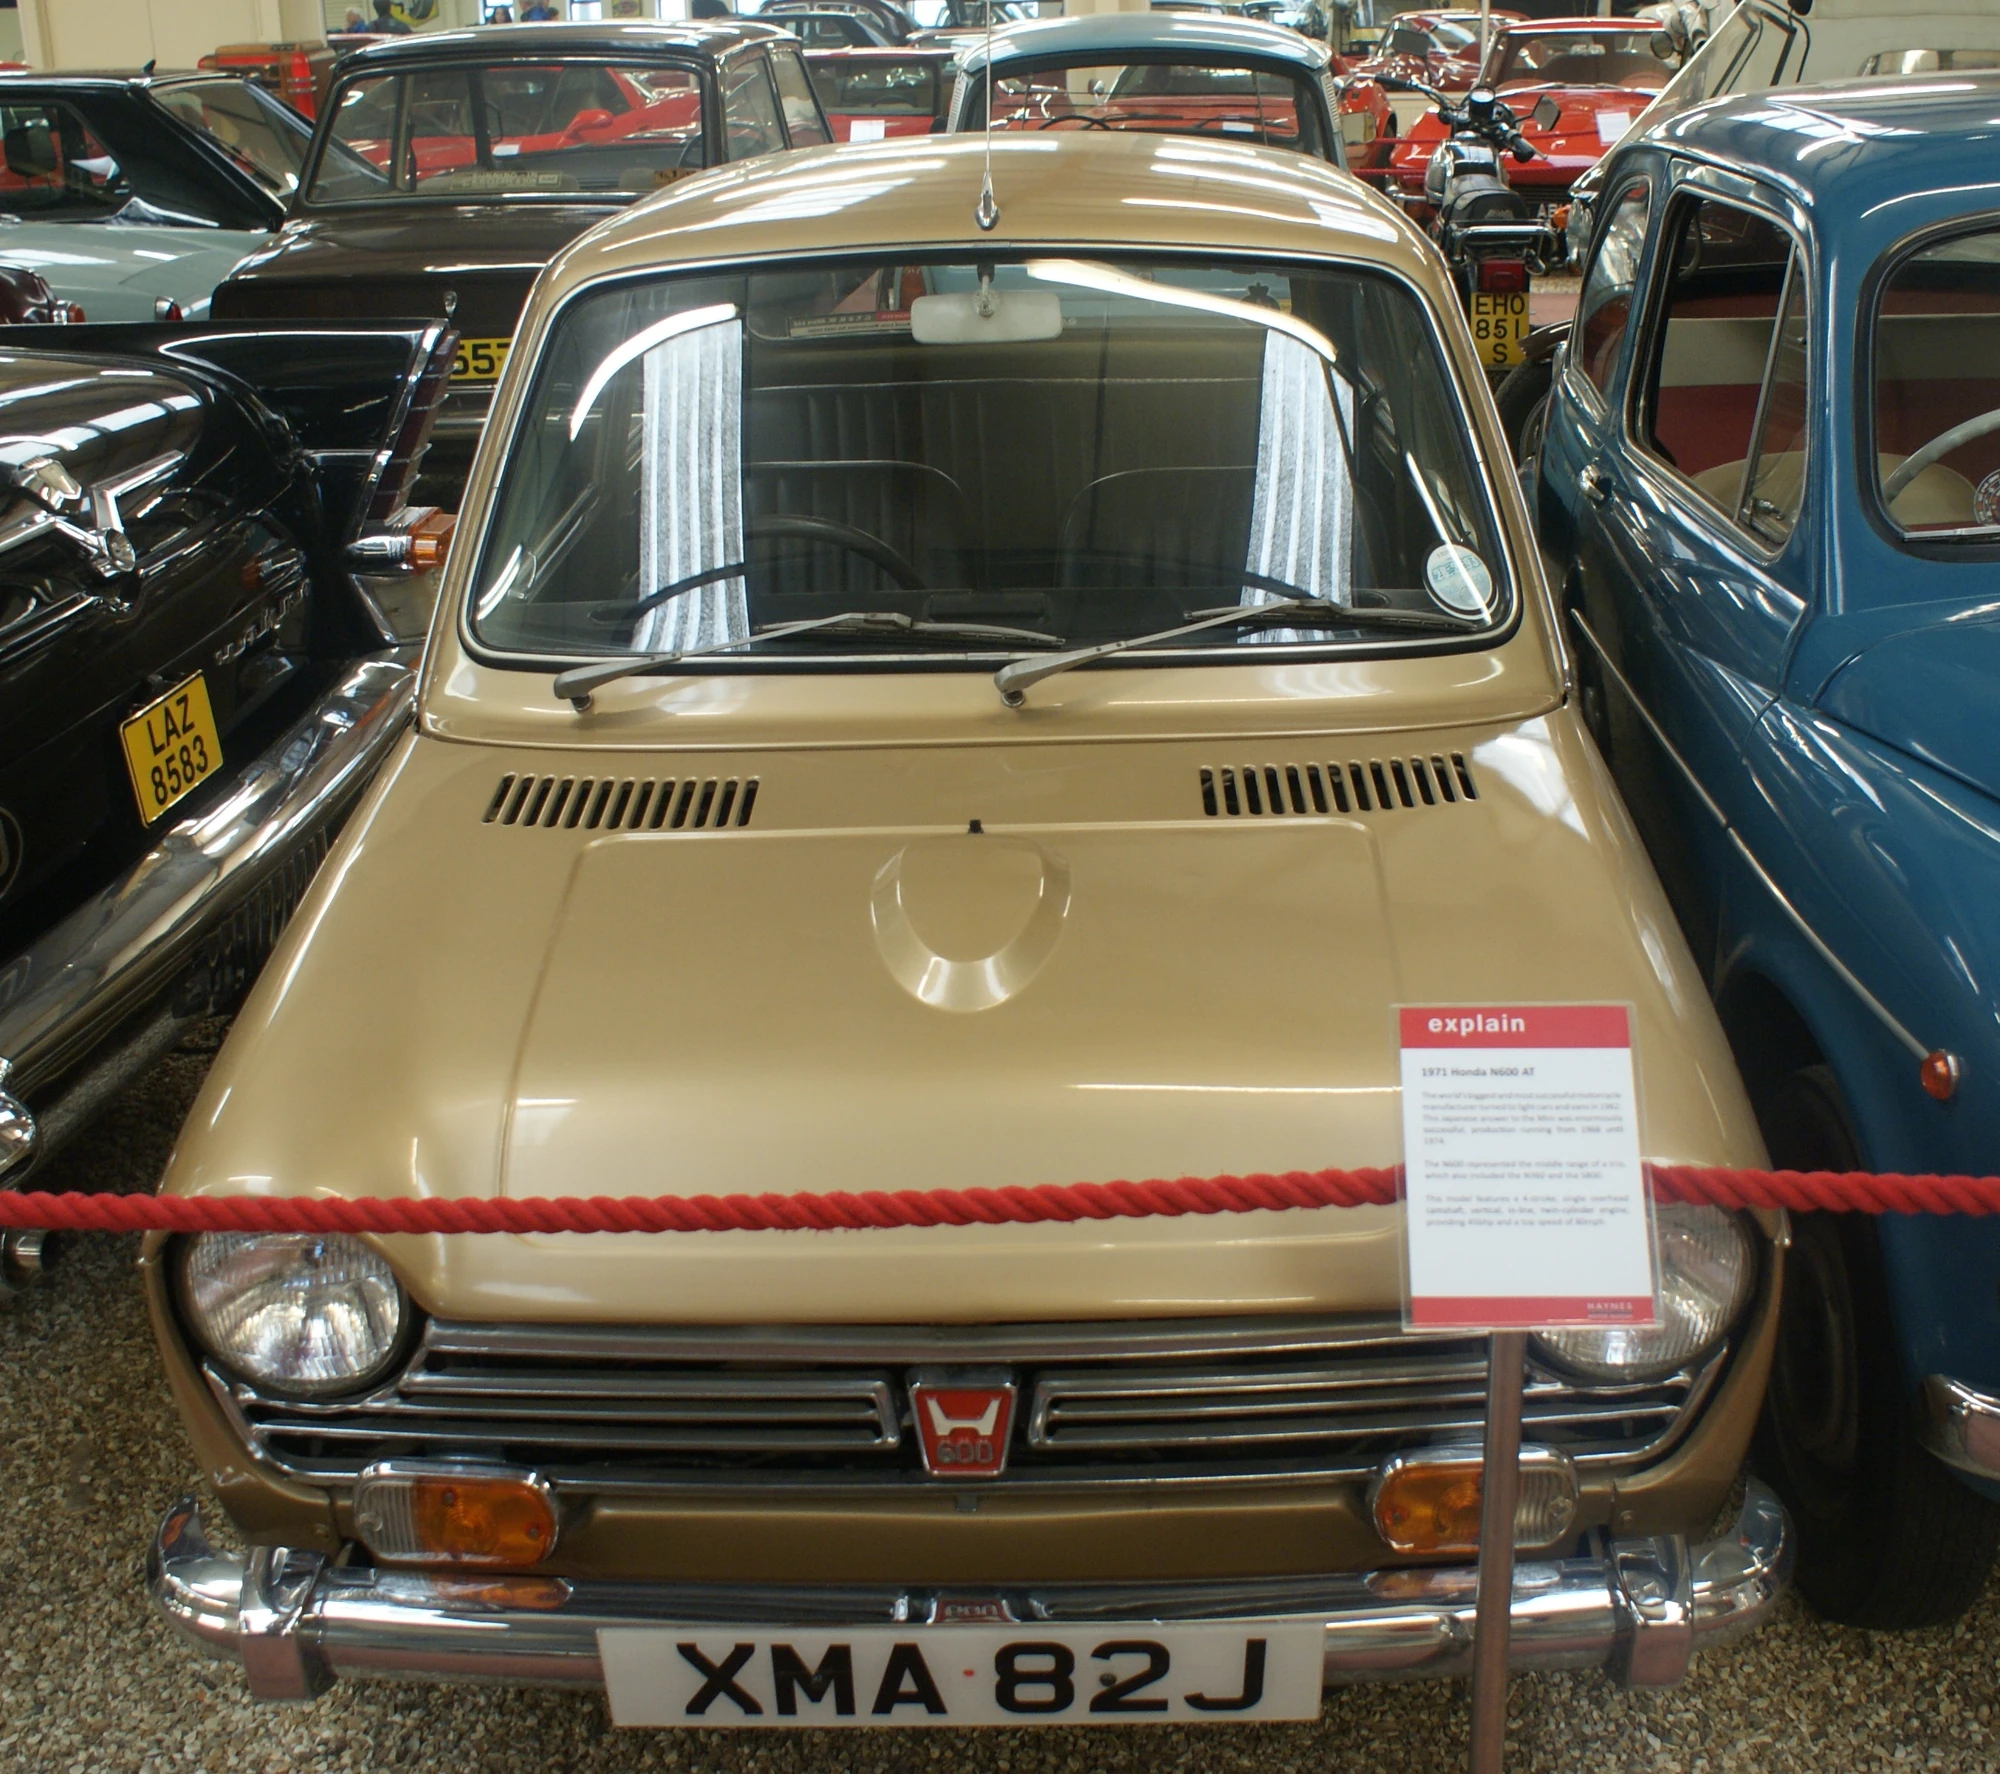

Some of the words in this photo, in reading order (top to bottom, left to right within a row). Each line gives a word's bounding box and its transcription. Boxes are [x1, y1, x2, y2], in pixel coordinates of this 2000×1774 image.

[1475, 293, 1525, 315] EHO
[1475, 318, 1519, 339] 851
[452, 342, 511, 375] 55
[1493, 342, 1508, 363] S
[146, 693, 195, 757] LAZ
[151, 734, 208, 806] 8583
[1428, 1014, 1525, 1037] explain
[1422, 1067, 1447, 1077] 1971
[1451, 1067, 1487, 1077] Honda
[1490, 1067, 1519, 1077] N600
[1522, 1067, 1535, 1077] AT
[937, 1439, 993, 1463] 600
[676, 1642, 948, 1716] XMA
[993, 1638, 1267, 1714] 82J
